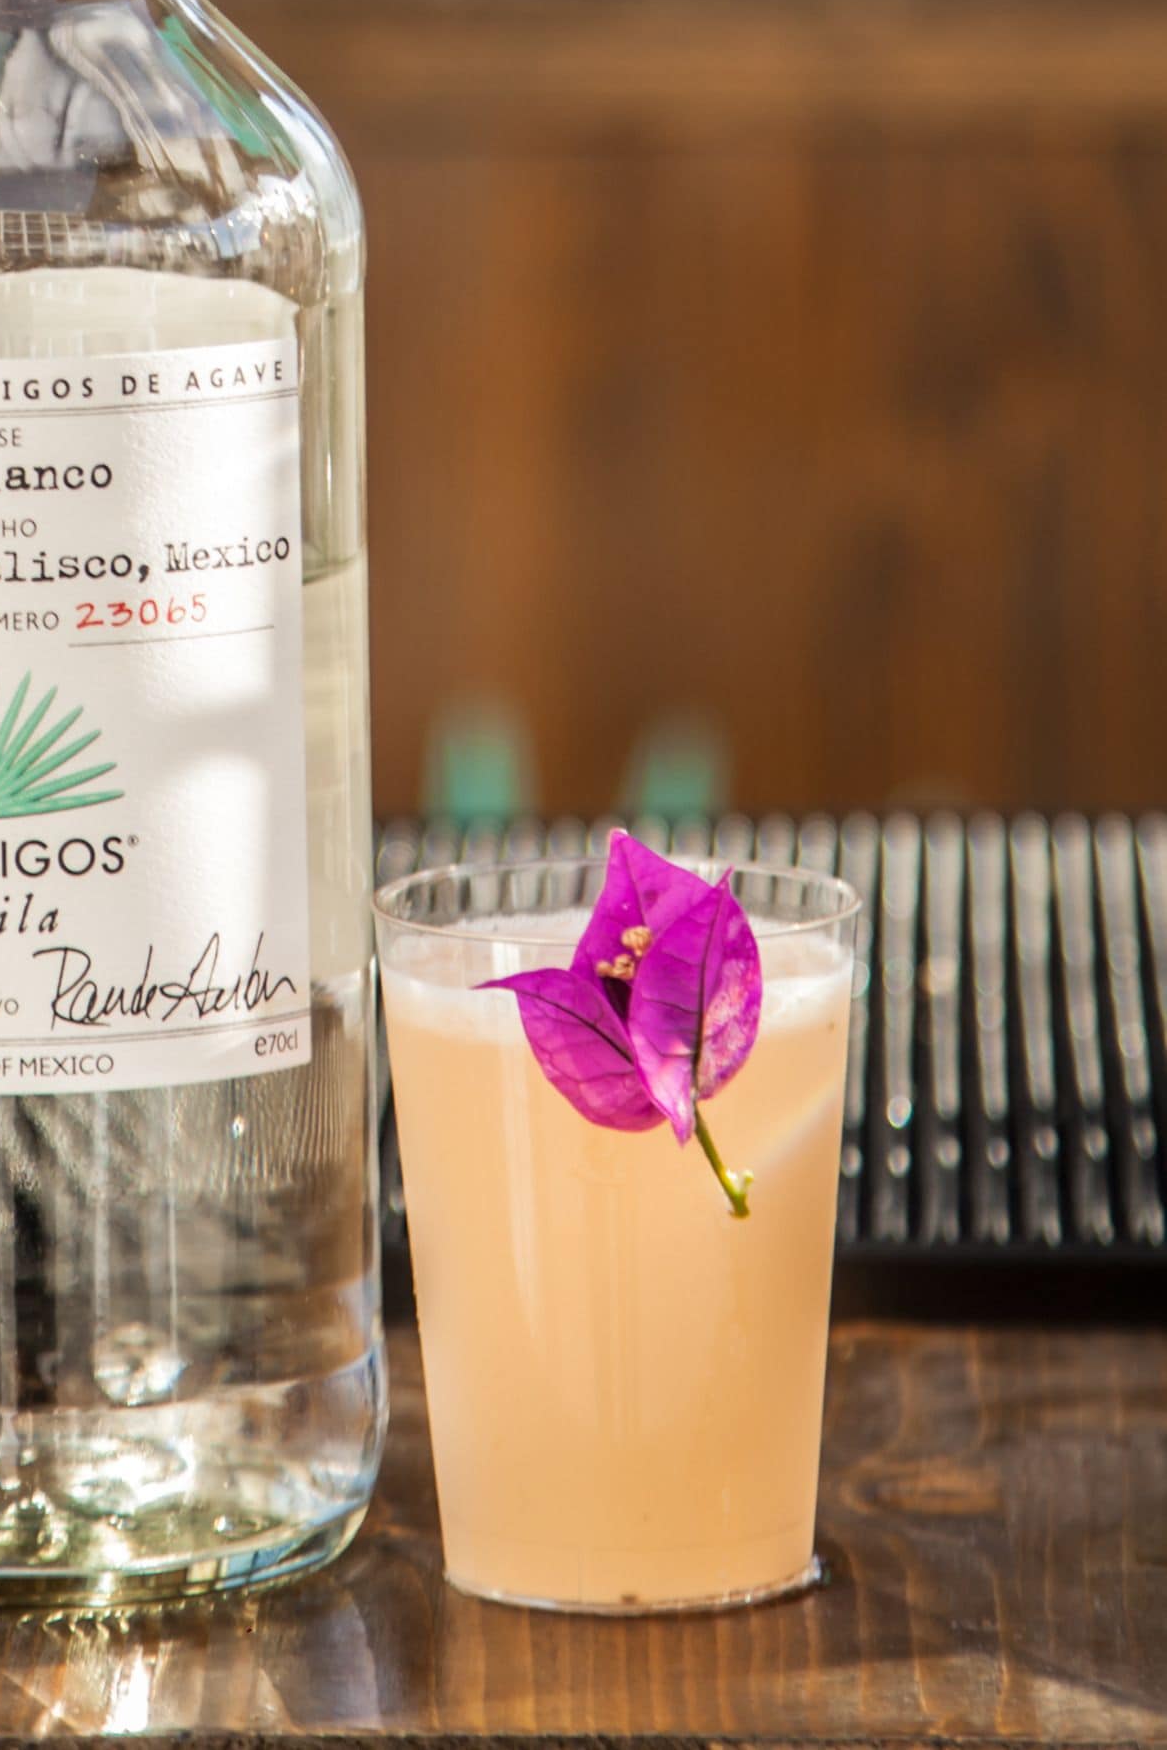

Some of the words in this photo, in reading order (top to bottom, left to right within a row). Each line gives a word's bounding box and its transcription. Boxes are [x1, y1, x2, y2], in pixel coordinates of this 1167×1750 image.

[121, 372, 160, 396] DE
[185, 359, 283, 391] AGAVE
[164, 536, 291, 574] Mexico
[75, 593, 208, 630] 23065
[19, 1053, 115, 1078] MEXICO
